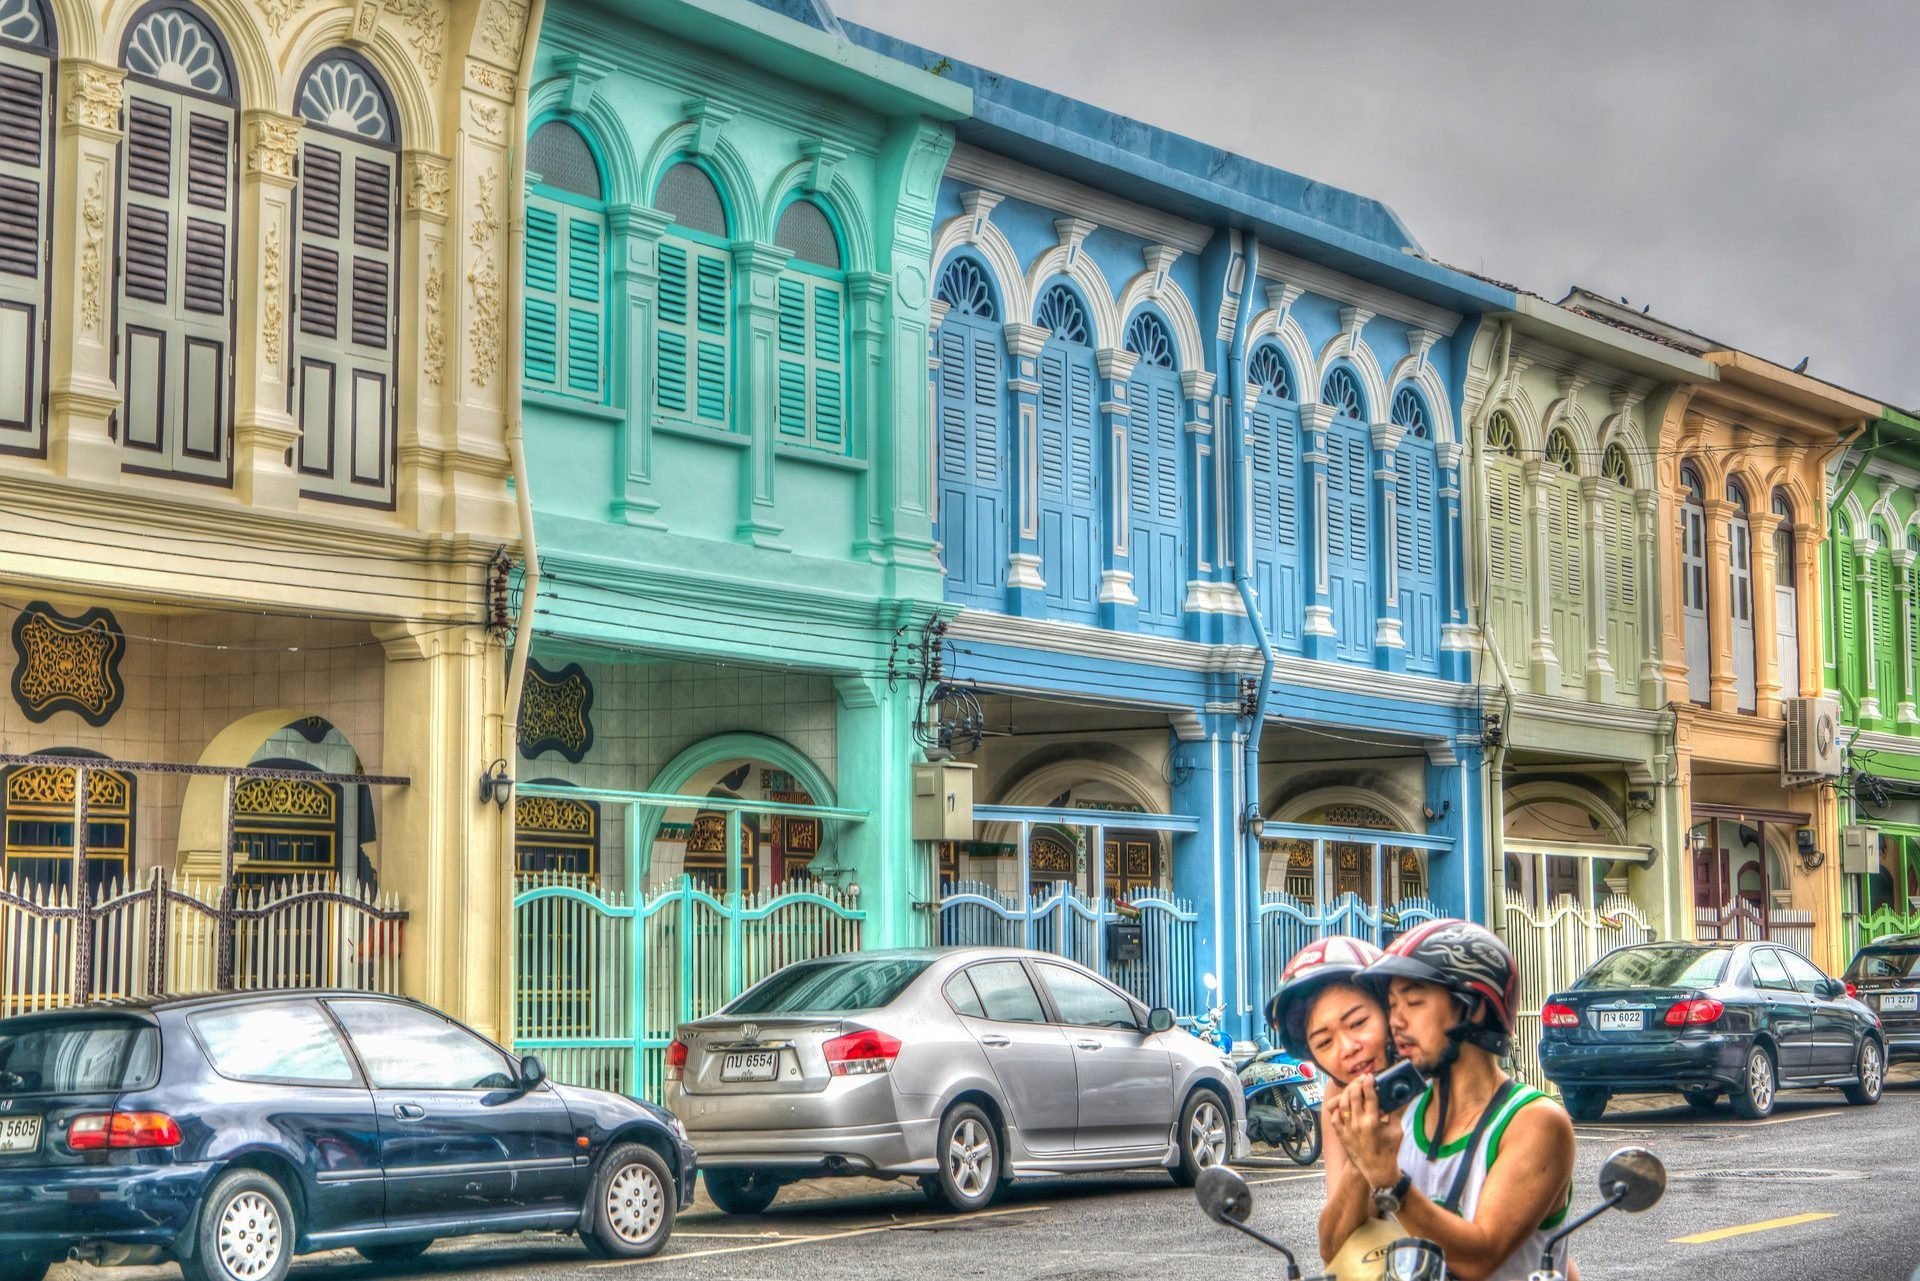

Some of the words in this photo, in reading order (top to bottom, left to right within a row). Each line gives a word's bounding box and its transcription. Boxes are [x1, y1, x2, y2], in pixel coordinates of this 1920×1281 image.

[1898, 996, 1915, 1004] 2273
[1619, 1012, 1640, 1022] 6022
[726, 1055, 743, 1069] กบ
[746, 1054, 773, 1067] 6554
[6, 1120, 37, 1137] 5605
